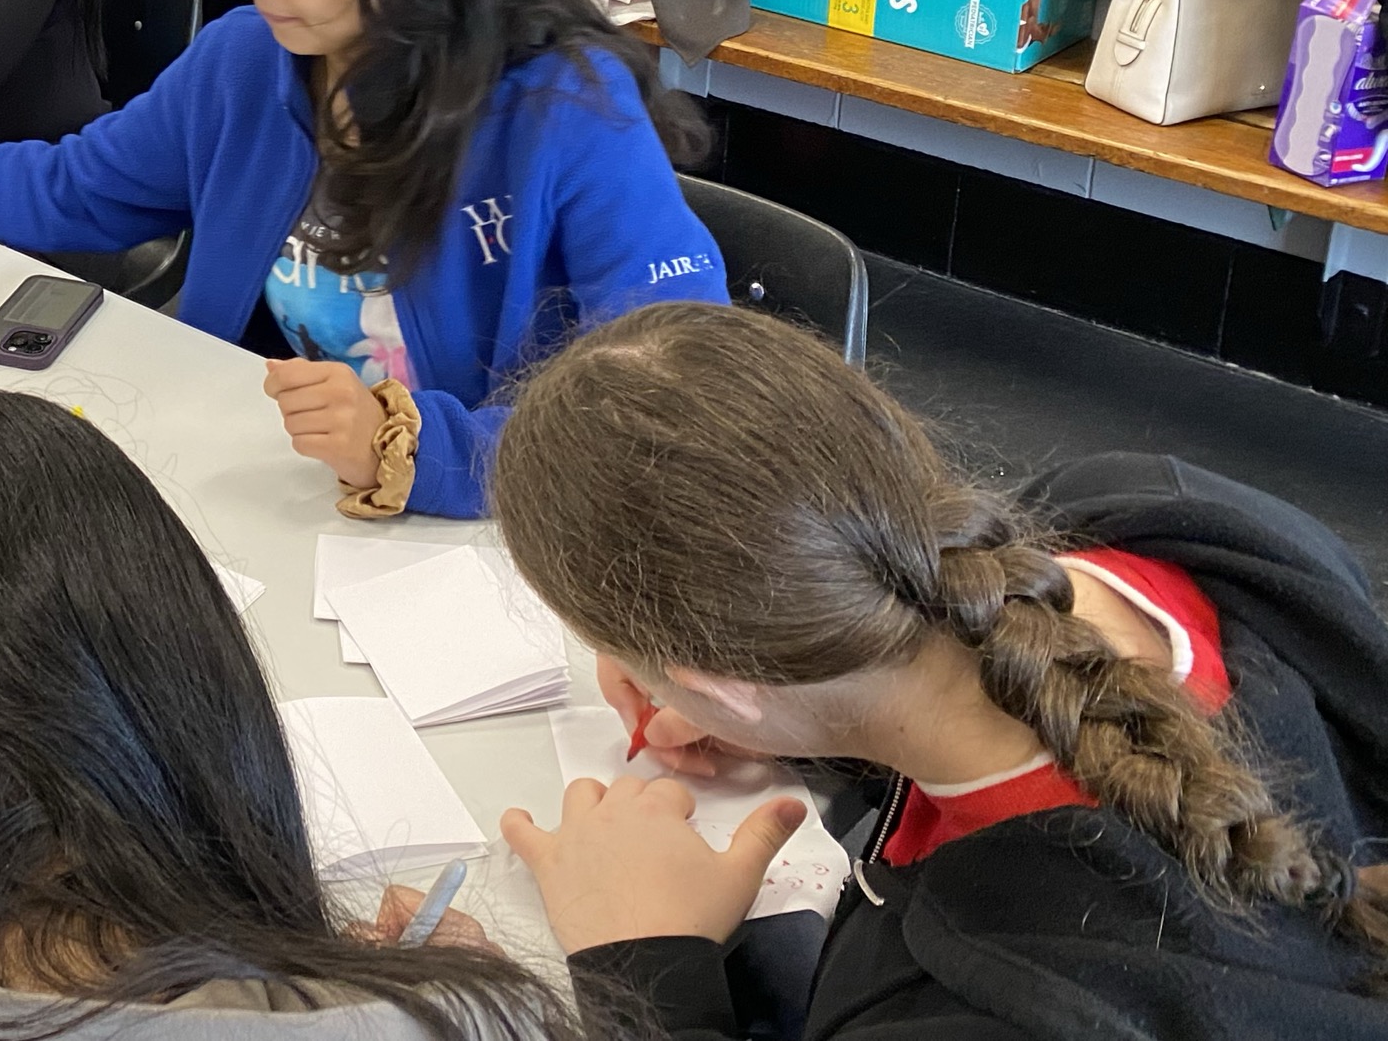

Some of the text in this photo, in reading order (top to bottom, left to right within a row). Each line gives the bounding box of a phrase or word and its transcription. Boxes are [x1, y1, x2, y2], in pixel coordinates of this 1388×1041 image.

[842, 1, 860, 15] 3
[967, 1, 978, 46] PEDIATRICIAN
[647, 253, 714, 284] JAIR
